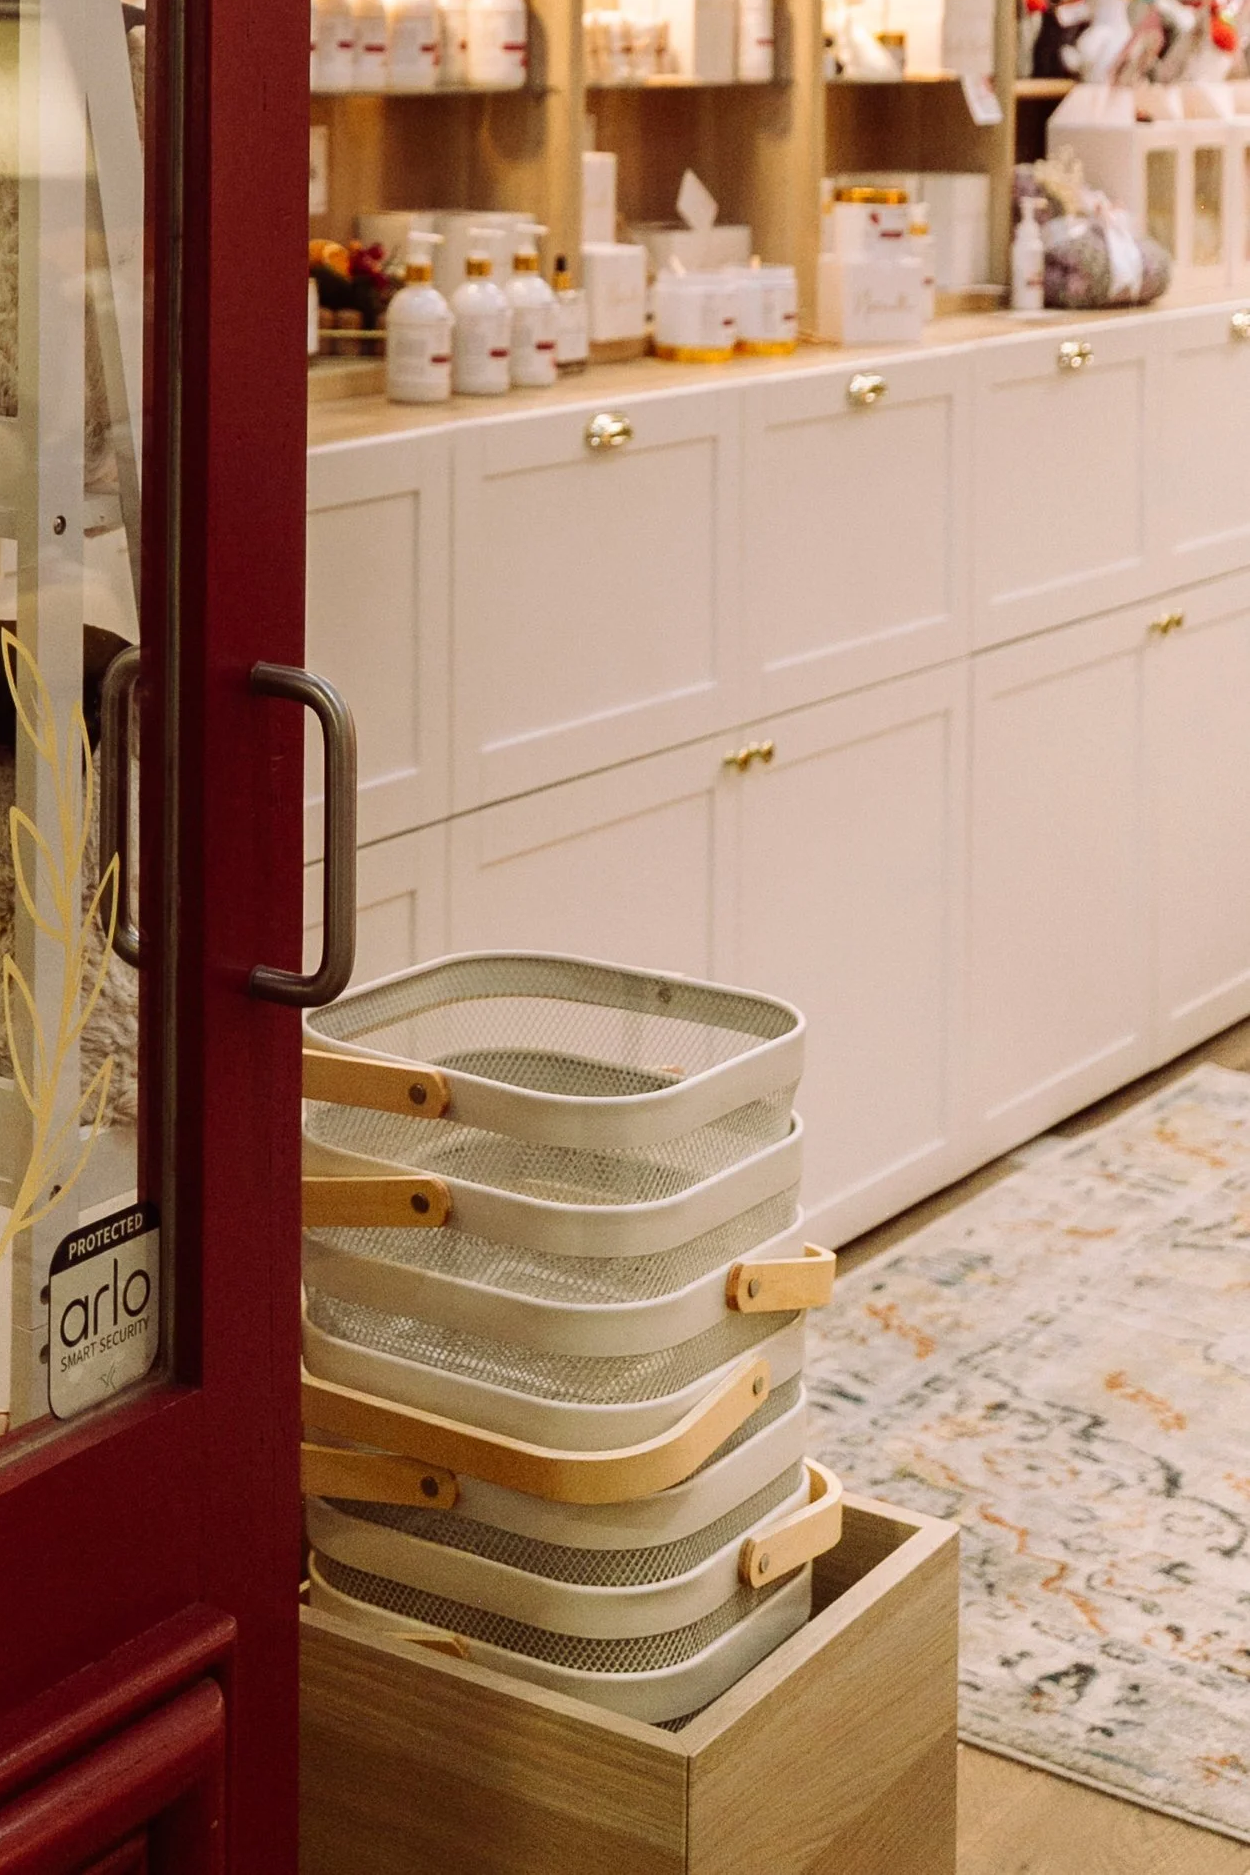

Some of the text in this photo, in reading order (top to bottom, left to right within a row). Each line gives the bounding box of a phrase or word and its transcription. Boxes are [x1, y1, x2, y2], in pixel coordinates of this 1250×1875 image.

[67, 1212, 144, 1261] PROTECTED
[60, 1258, 151, 1348] arlo
[60, 1314, 152, 1373] SMART SECURITY
